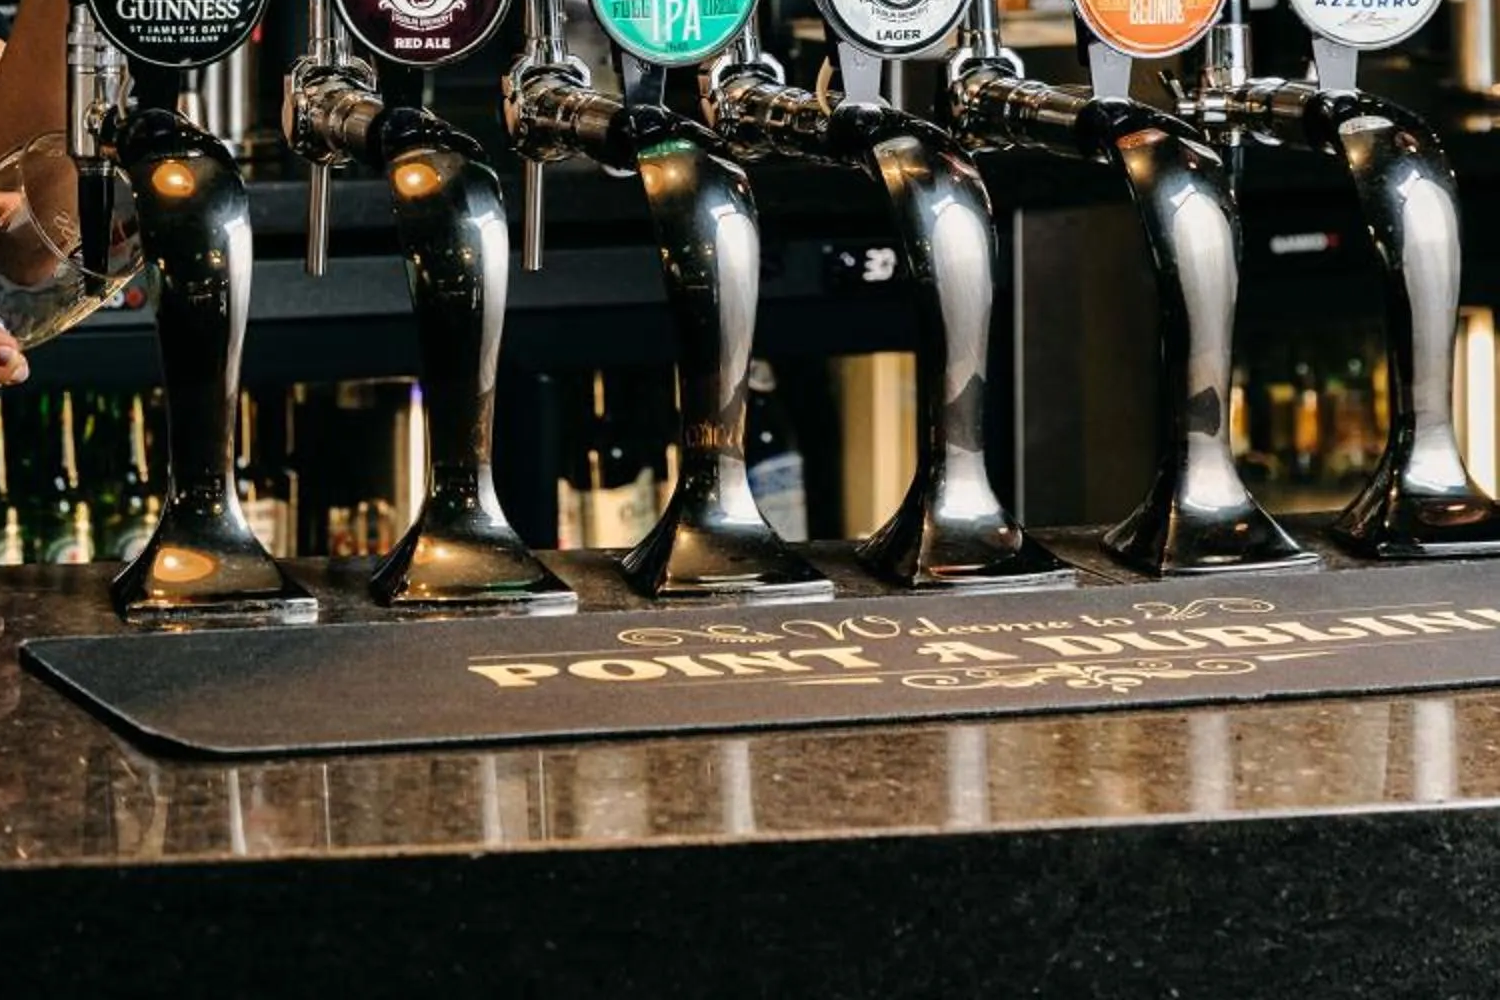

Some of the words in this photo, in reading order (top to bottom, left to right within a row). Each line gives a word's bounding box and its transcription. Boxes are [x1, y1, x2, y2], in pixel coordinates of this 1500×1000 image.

[201, 23, 229, 34] GATE
[876, 29, 921, 41] LAGER
[394, 37, 422, 50] RED
[425, 37, 451, 50] ALE
[1079, 614, 1135, 629] to
[468, 646, 882, 688] POINT
[916, 640, 1020, 663] A
